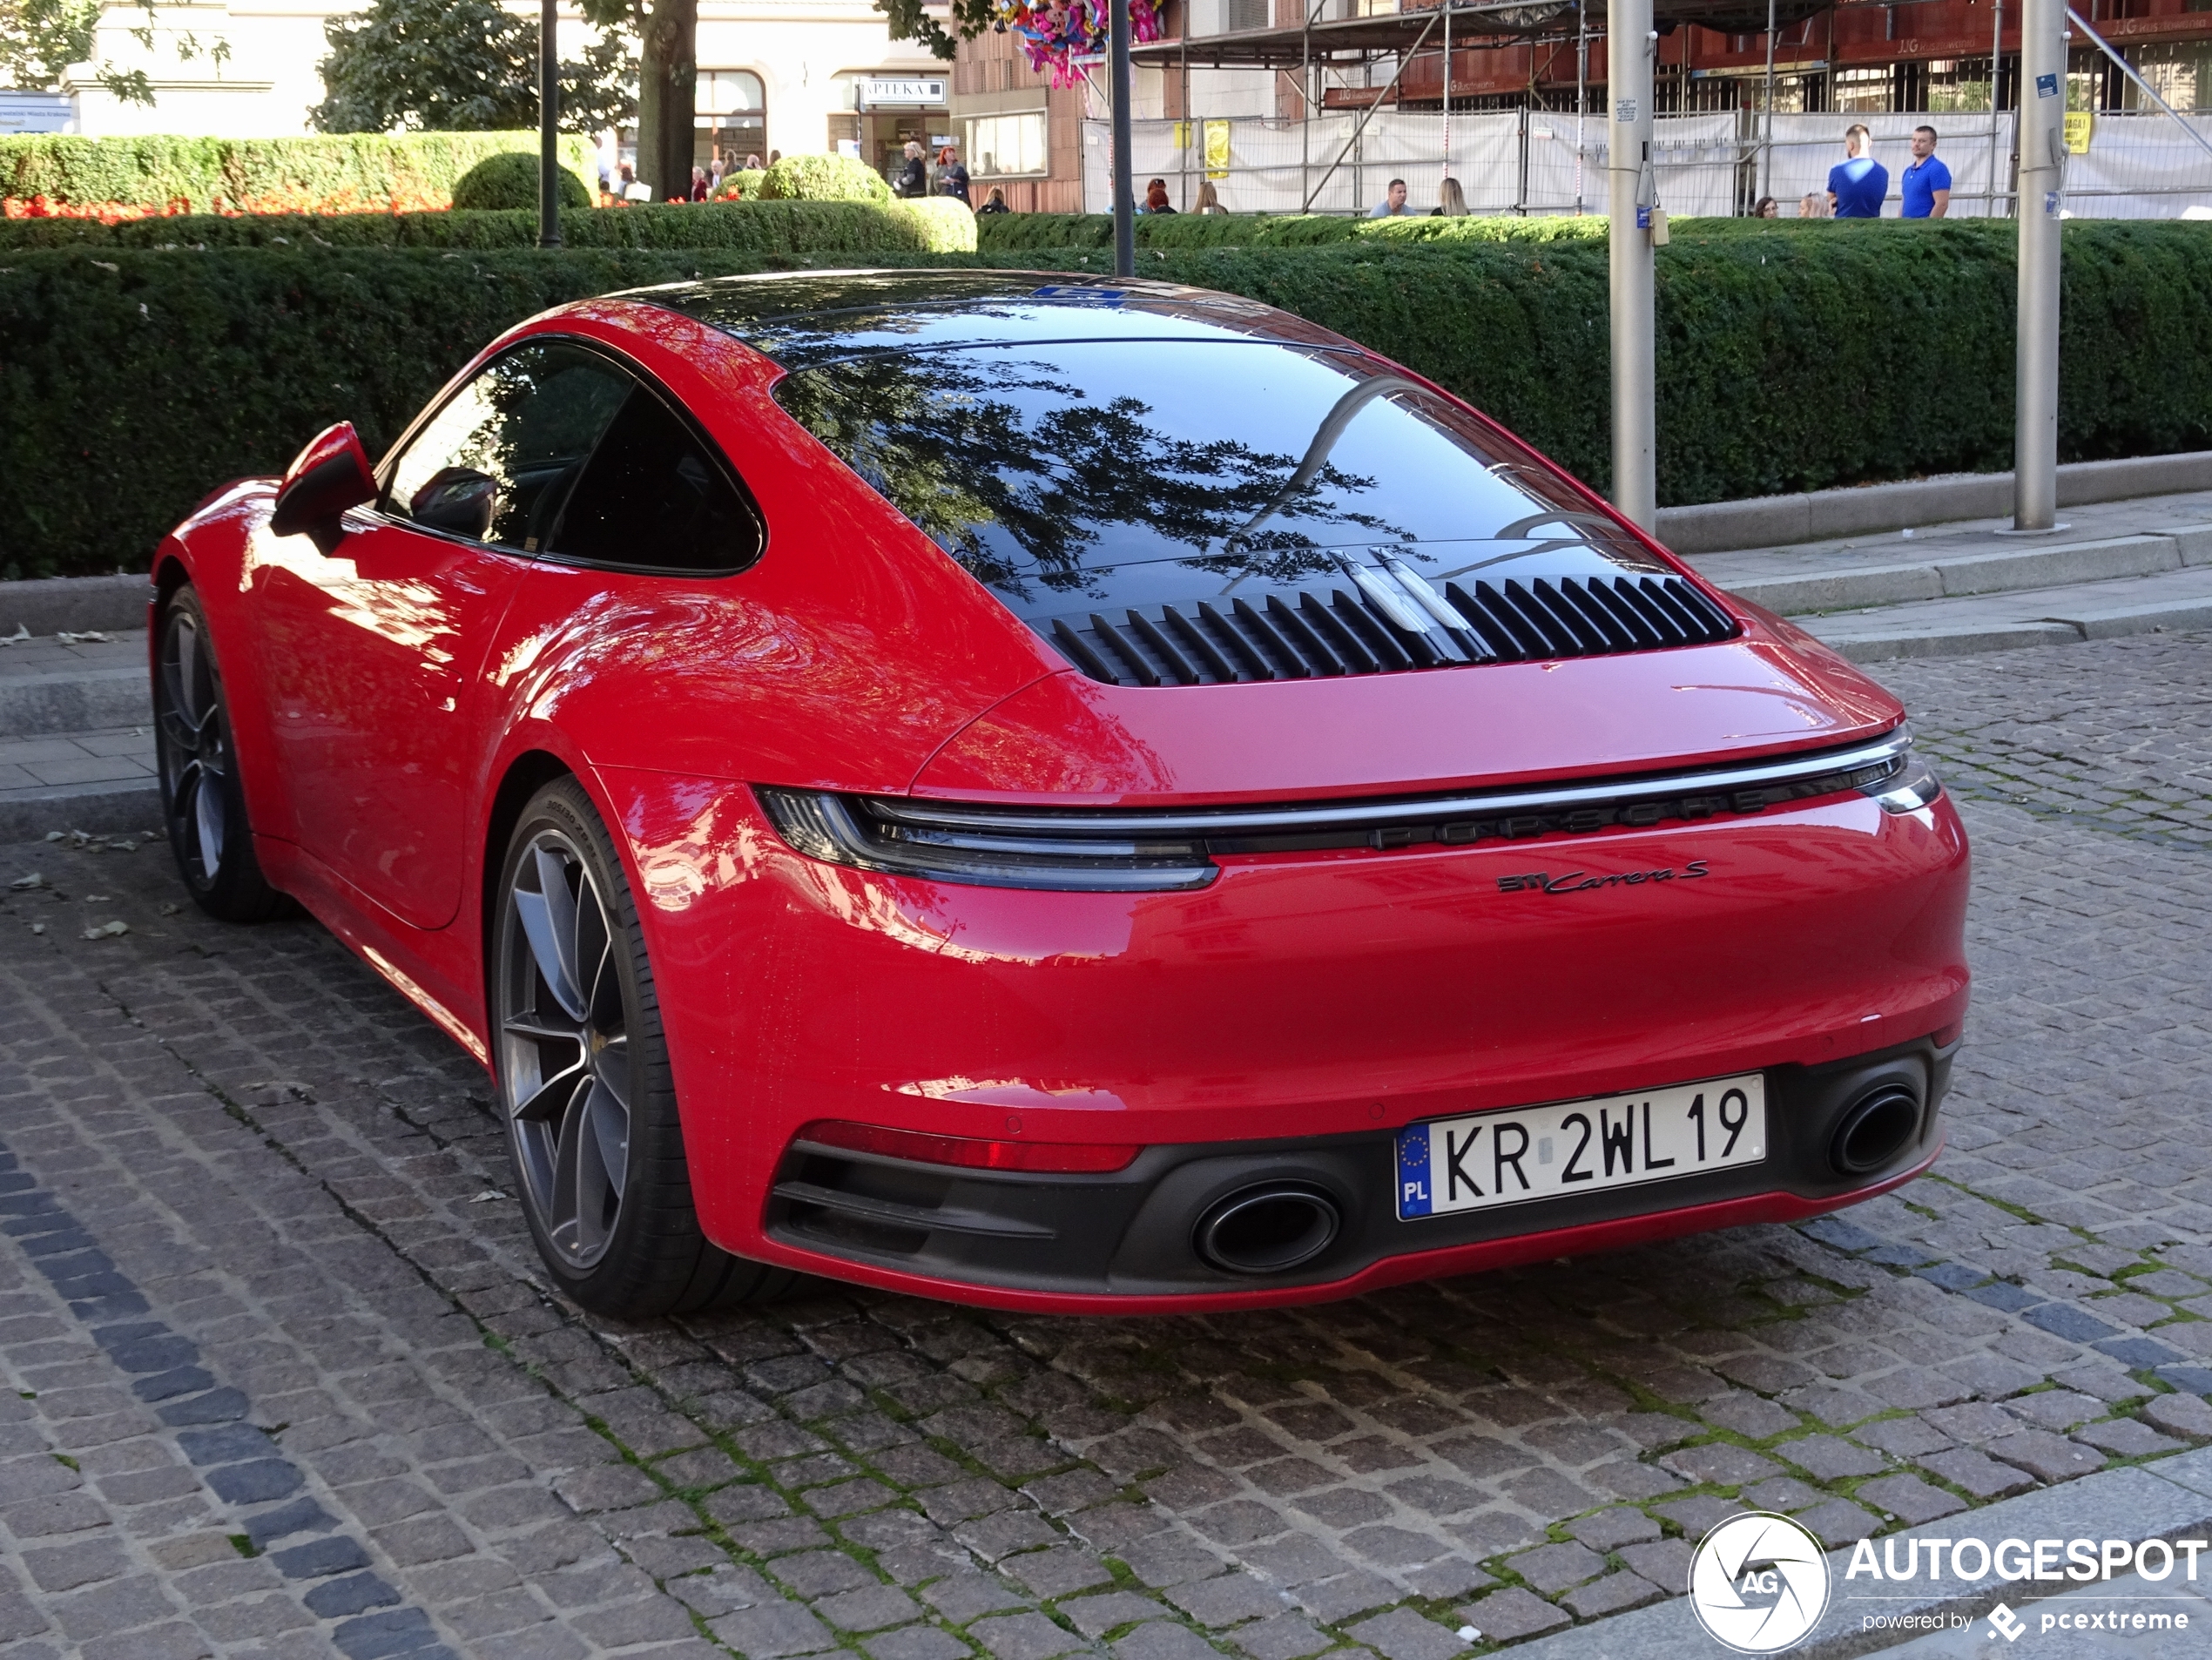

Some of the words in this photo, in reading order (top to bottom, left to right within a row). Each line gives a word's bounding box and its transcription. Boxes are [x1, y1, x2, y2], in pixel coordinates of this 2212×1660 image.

[2112, 17, 2137, 36] JJG
[1898, 38, 1919, 54] JJG
[1371, 790, 1765, 851] PORSCHE
[1497, 872, 1548, 893] 911
[1543, 867, 1676, 894] Carrera
[1680, 860, 1710, 879] S
[1446, 1121, 1533, 1202] KR
[1559, 1088, 1749, 1184] 2WL19
[1404, 1181, 1428, 1203] PL
